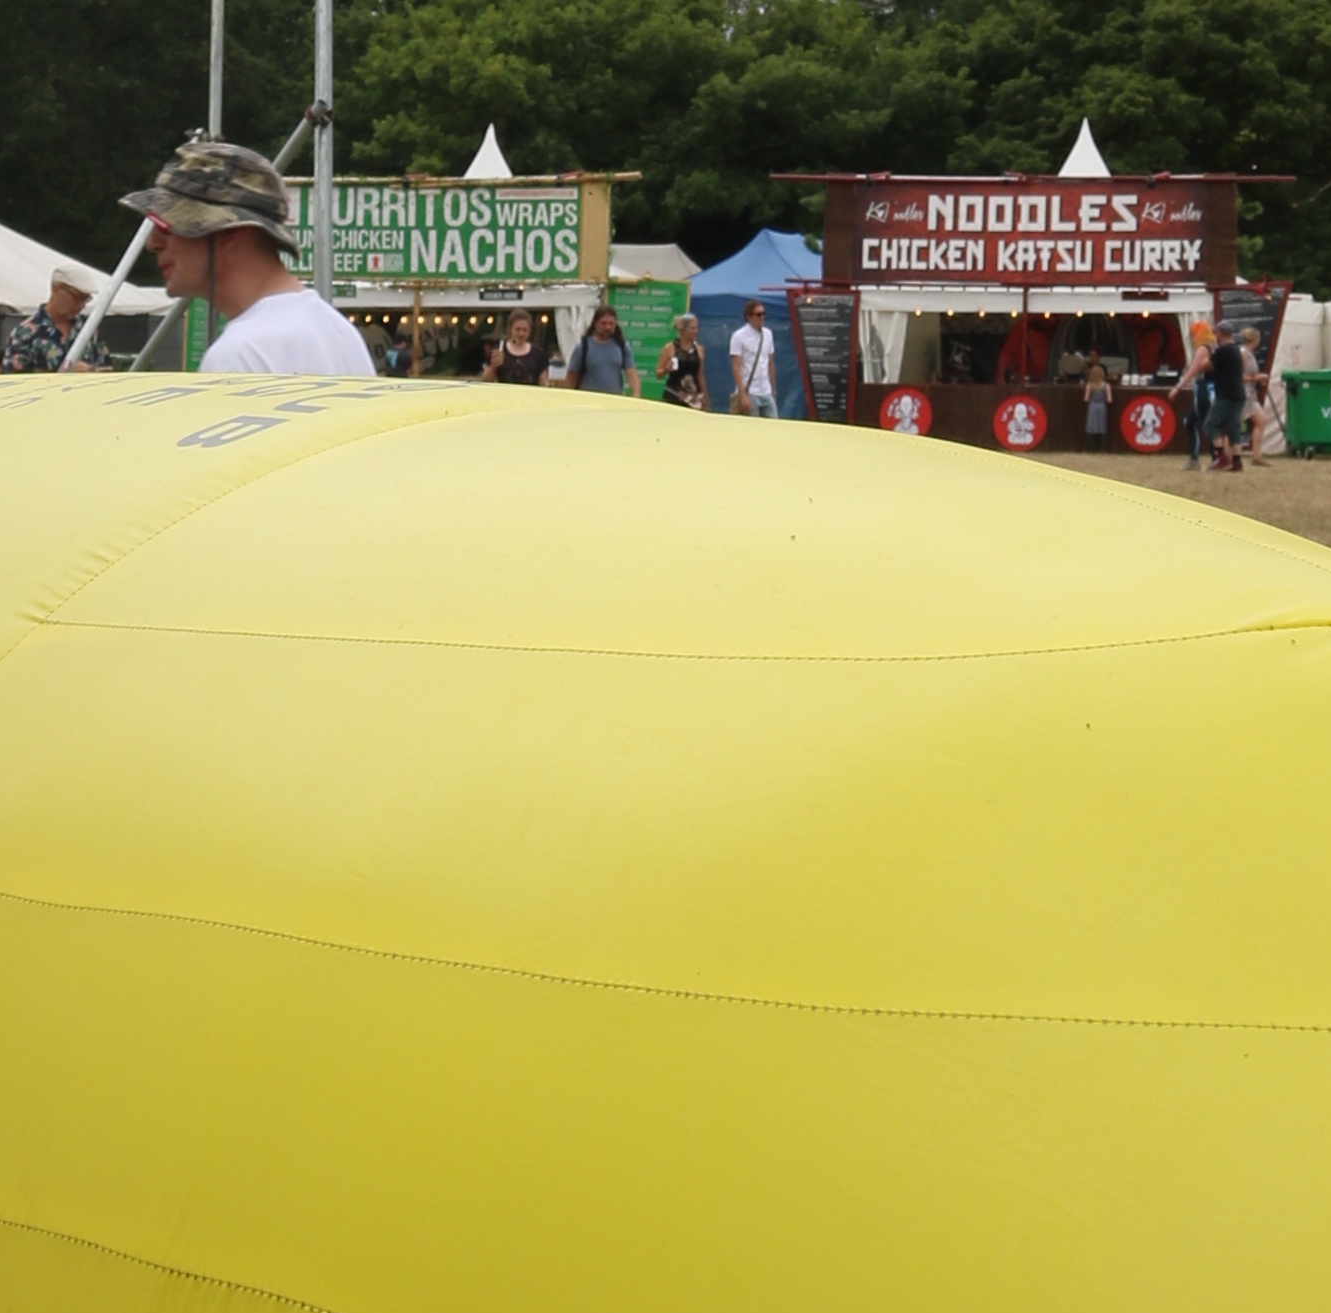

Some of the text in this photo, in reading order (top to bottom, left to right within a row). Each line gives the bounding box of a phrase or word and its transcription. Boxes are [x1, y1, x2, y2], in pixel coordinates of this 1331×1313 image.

[307, 187, 579, 227] URRITOS WRAPS
[927, 194, 1139, 233] NOODLES
[331, 229, 405, 250] CHICKEN
[410, 228, 579, 274] NACHOS
[333, 253, 363, 272] EEF
[861, 238, 1203, 273] CHICKEN KATSU CURRY
